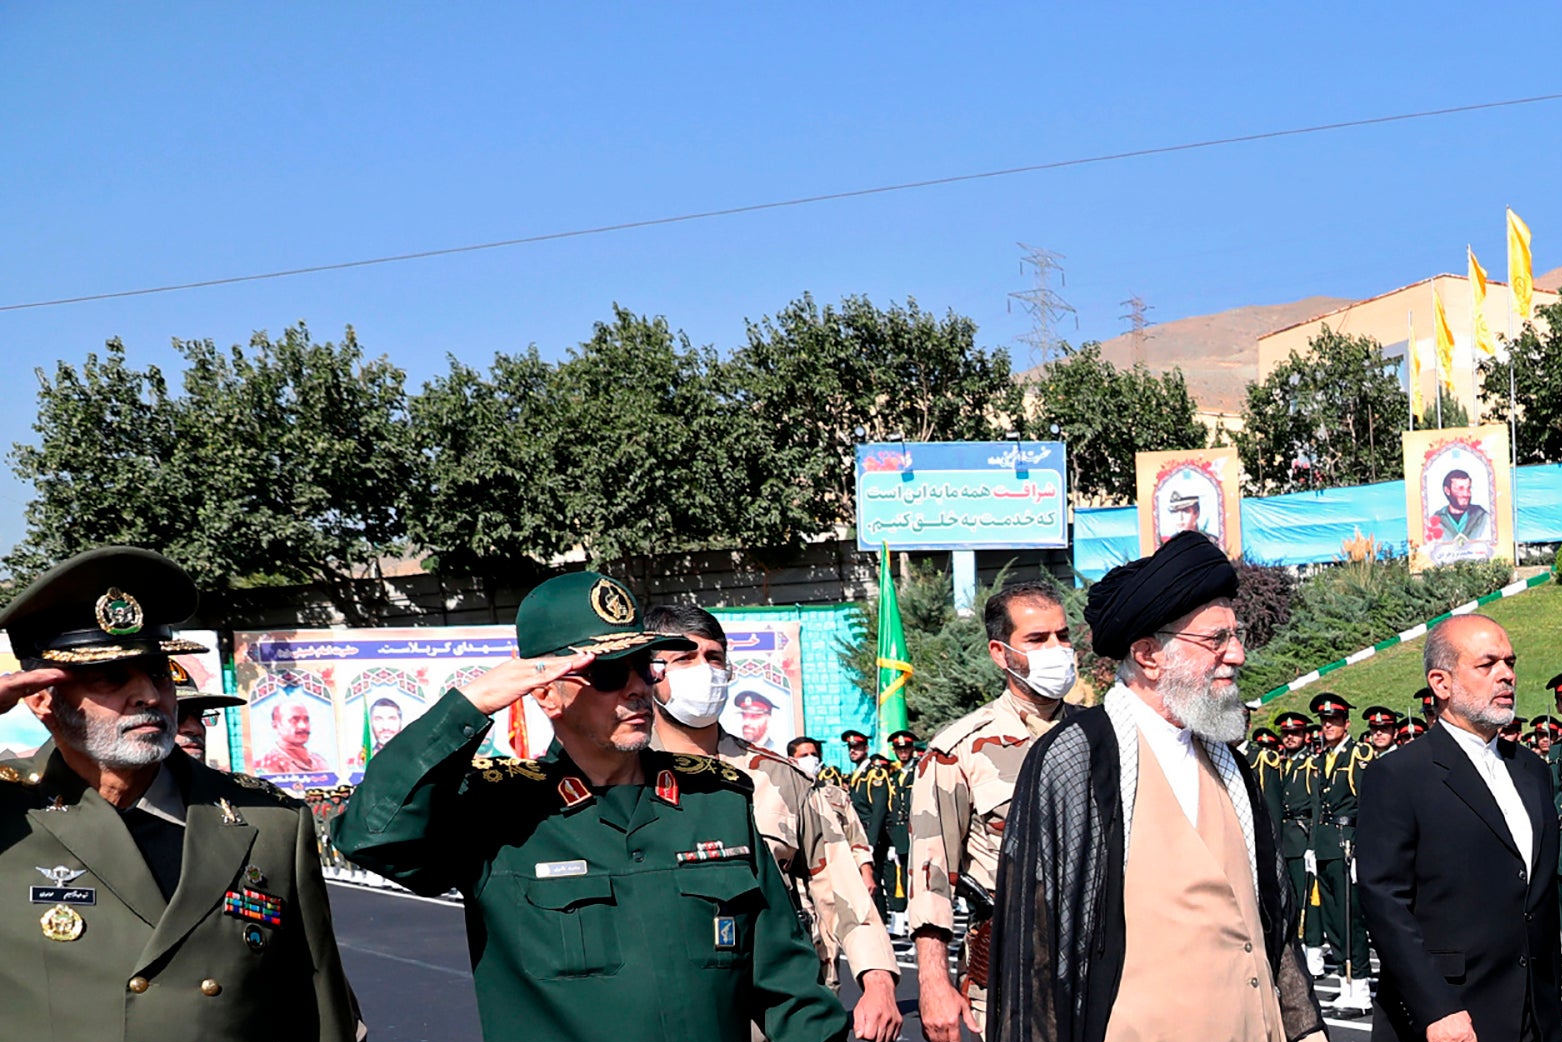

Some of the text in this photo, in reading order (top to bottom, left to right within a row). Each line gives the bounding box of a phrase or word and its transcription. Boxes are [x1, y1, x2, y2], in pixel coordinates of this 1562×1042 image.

[866, 481, 1056, 504] شرافت همه ما به این است
[911, 512, 959, 533] خلق
[960, 515, 978, 531] به
[979, 510, 1036, 526] خدمت
[1036, 511, 1056, 526] که
